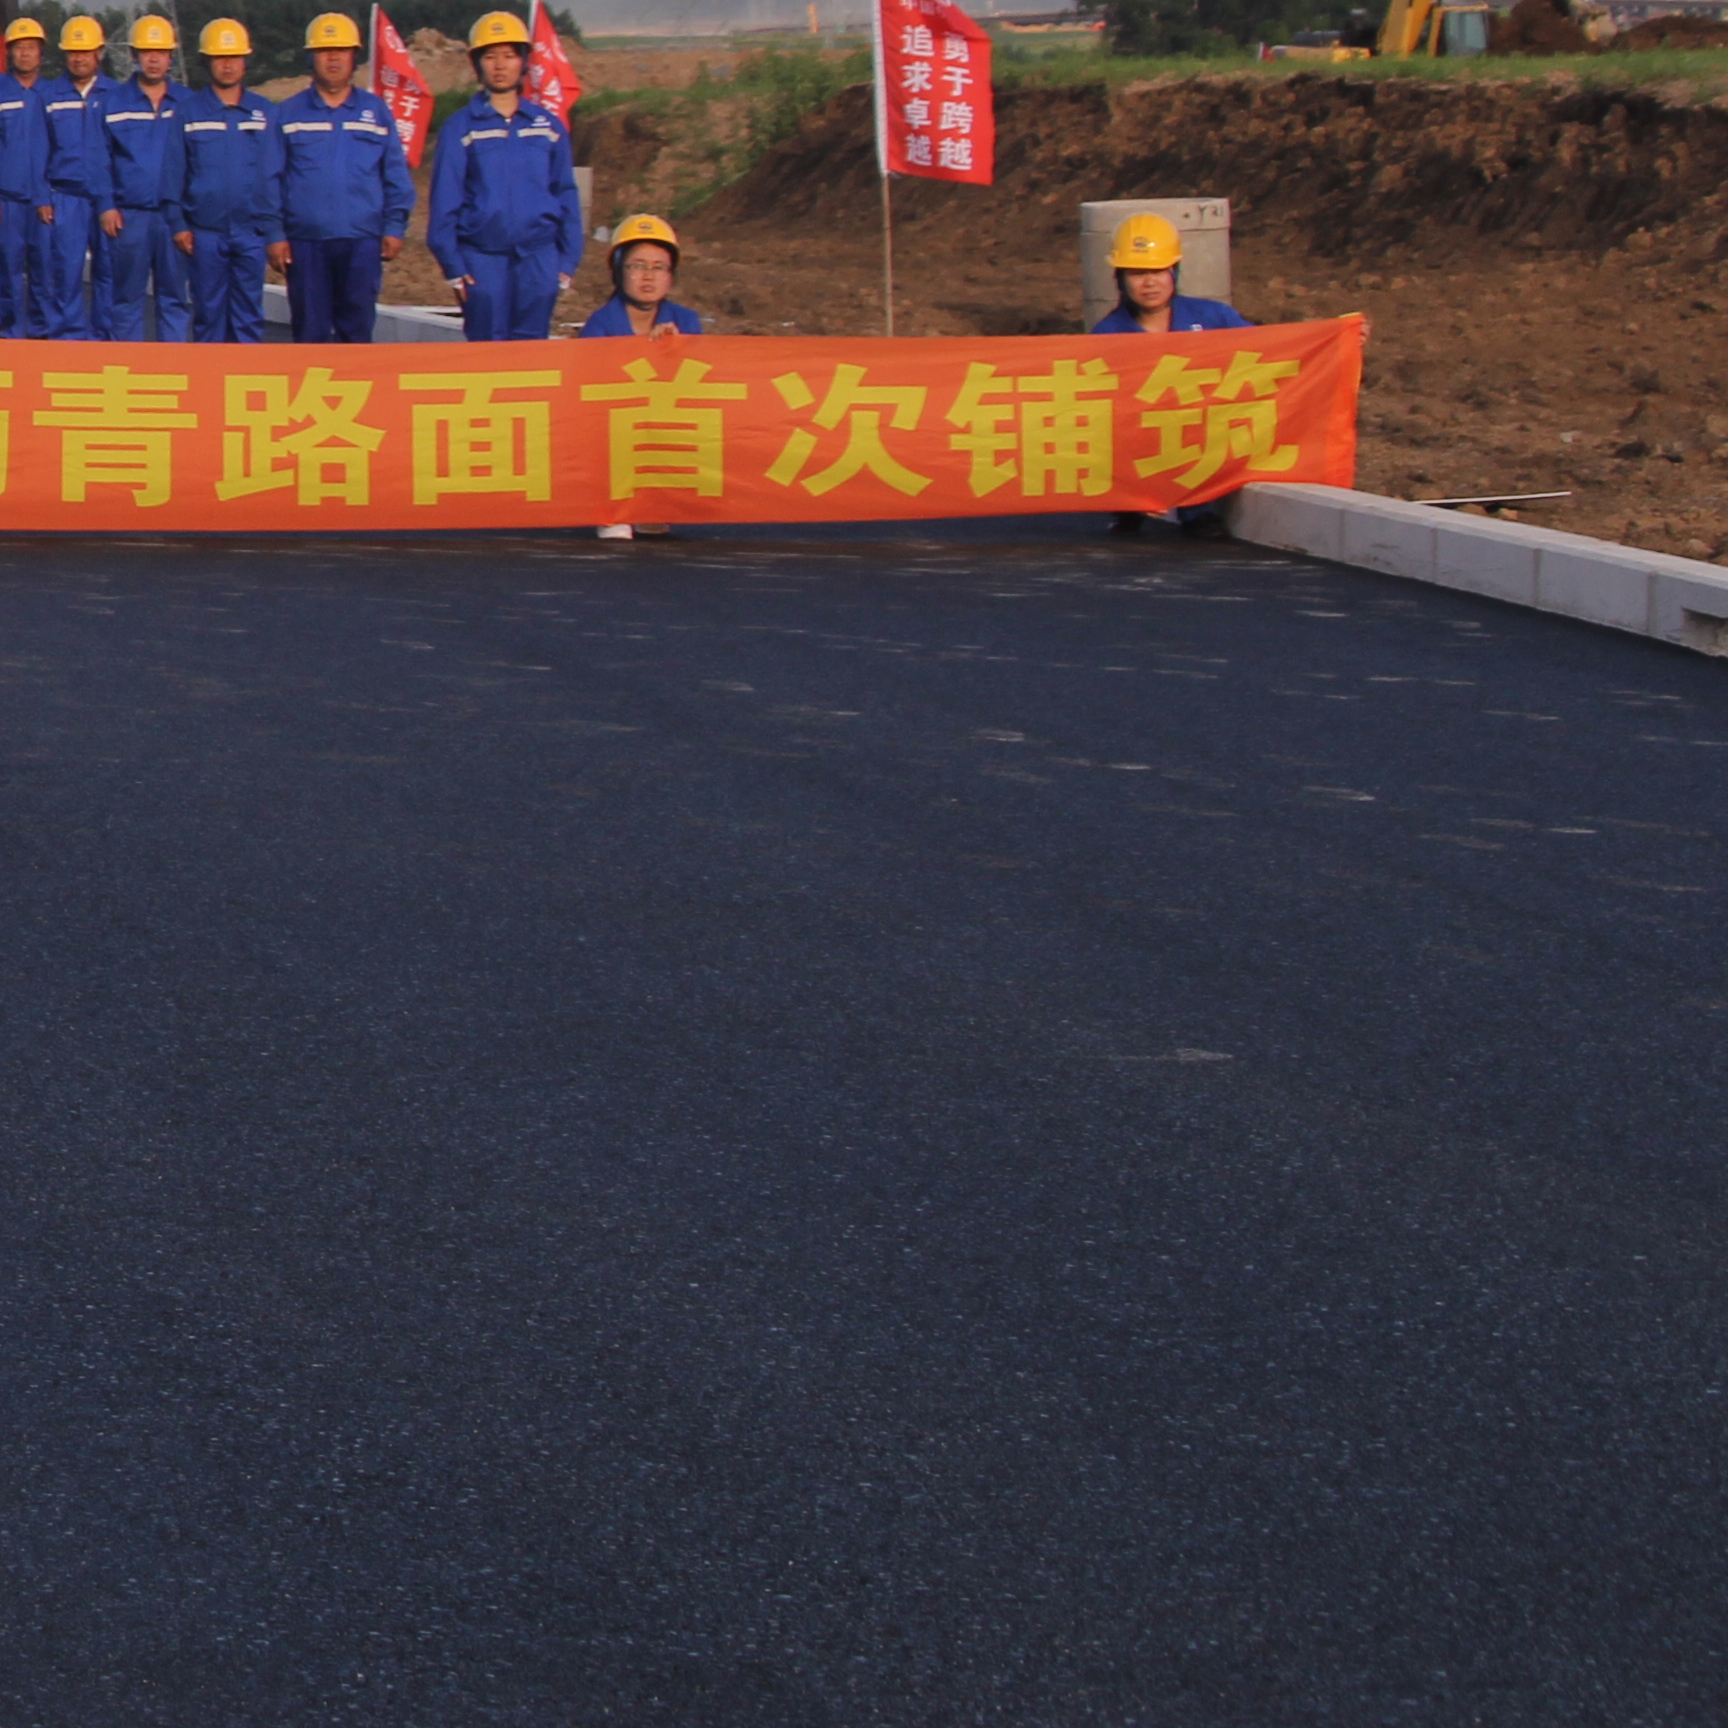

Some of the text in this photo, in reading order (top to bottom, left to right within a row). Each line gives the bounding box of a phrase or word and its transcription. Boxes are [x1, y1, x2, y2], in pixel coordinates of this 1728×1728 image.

[899, 25, 935, 167] 追求卓越
[937, 30, 974, 171] 勇于跨越
